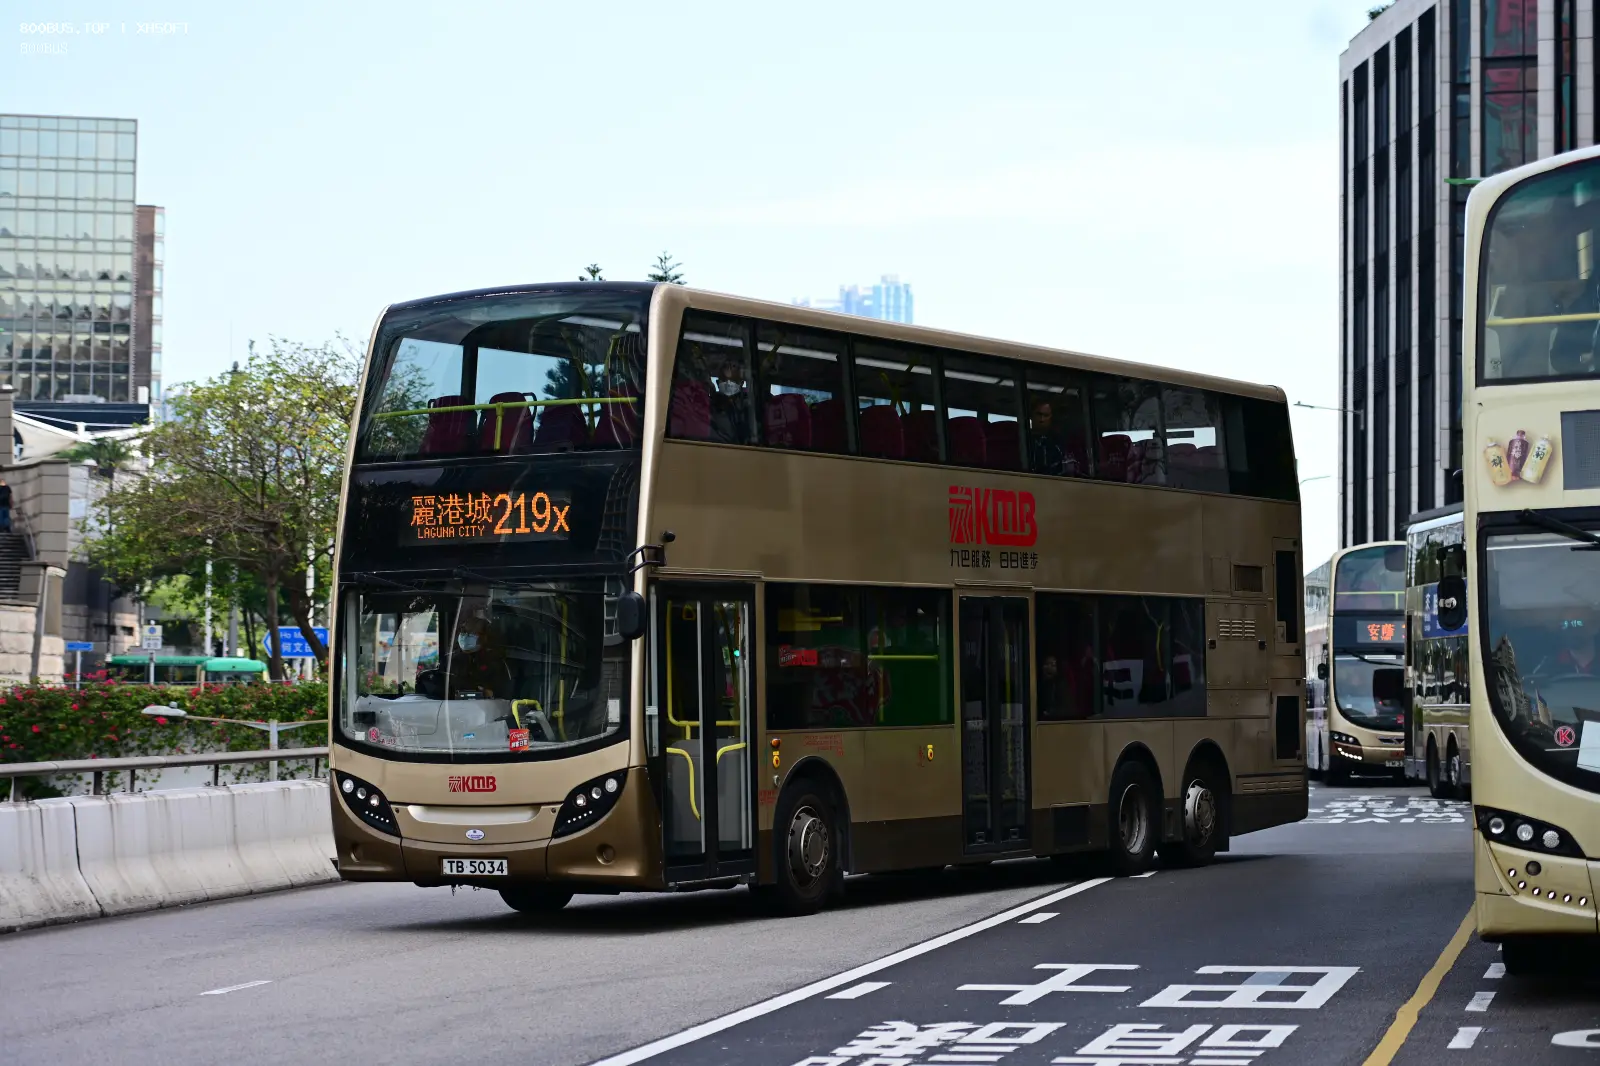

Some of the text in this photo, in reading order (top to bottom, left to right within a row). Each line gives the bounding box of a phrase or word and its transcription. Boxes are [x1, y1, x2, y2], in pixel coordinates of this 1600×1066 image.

[411, 492, 493, 526] 麗港城
[974, 487, 1038, 547] KMB
[417, 525, 485, 539] LAGUNA CITY
[1000, 551, 1039, 570] 日日進步
[462, 776, 496, 793] KMB
[447, 860, 505, 874] TB 5034
